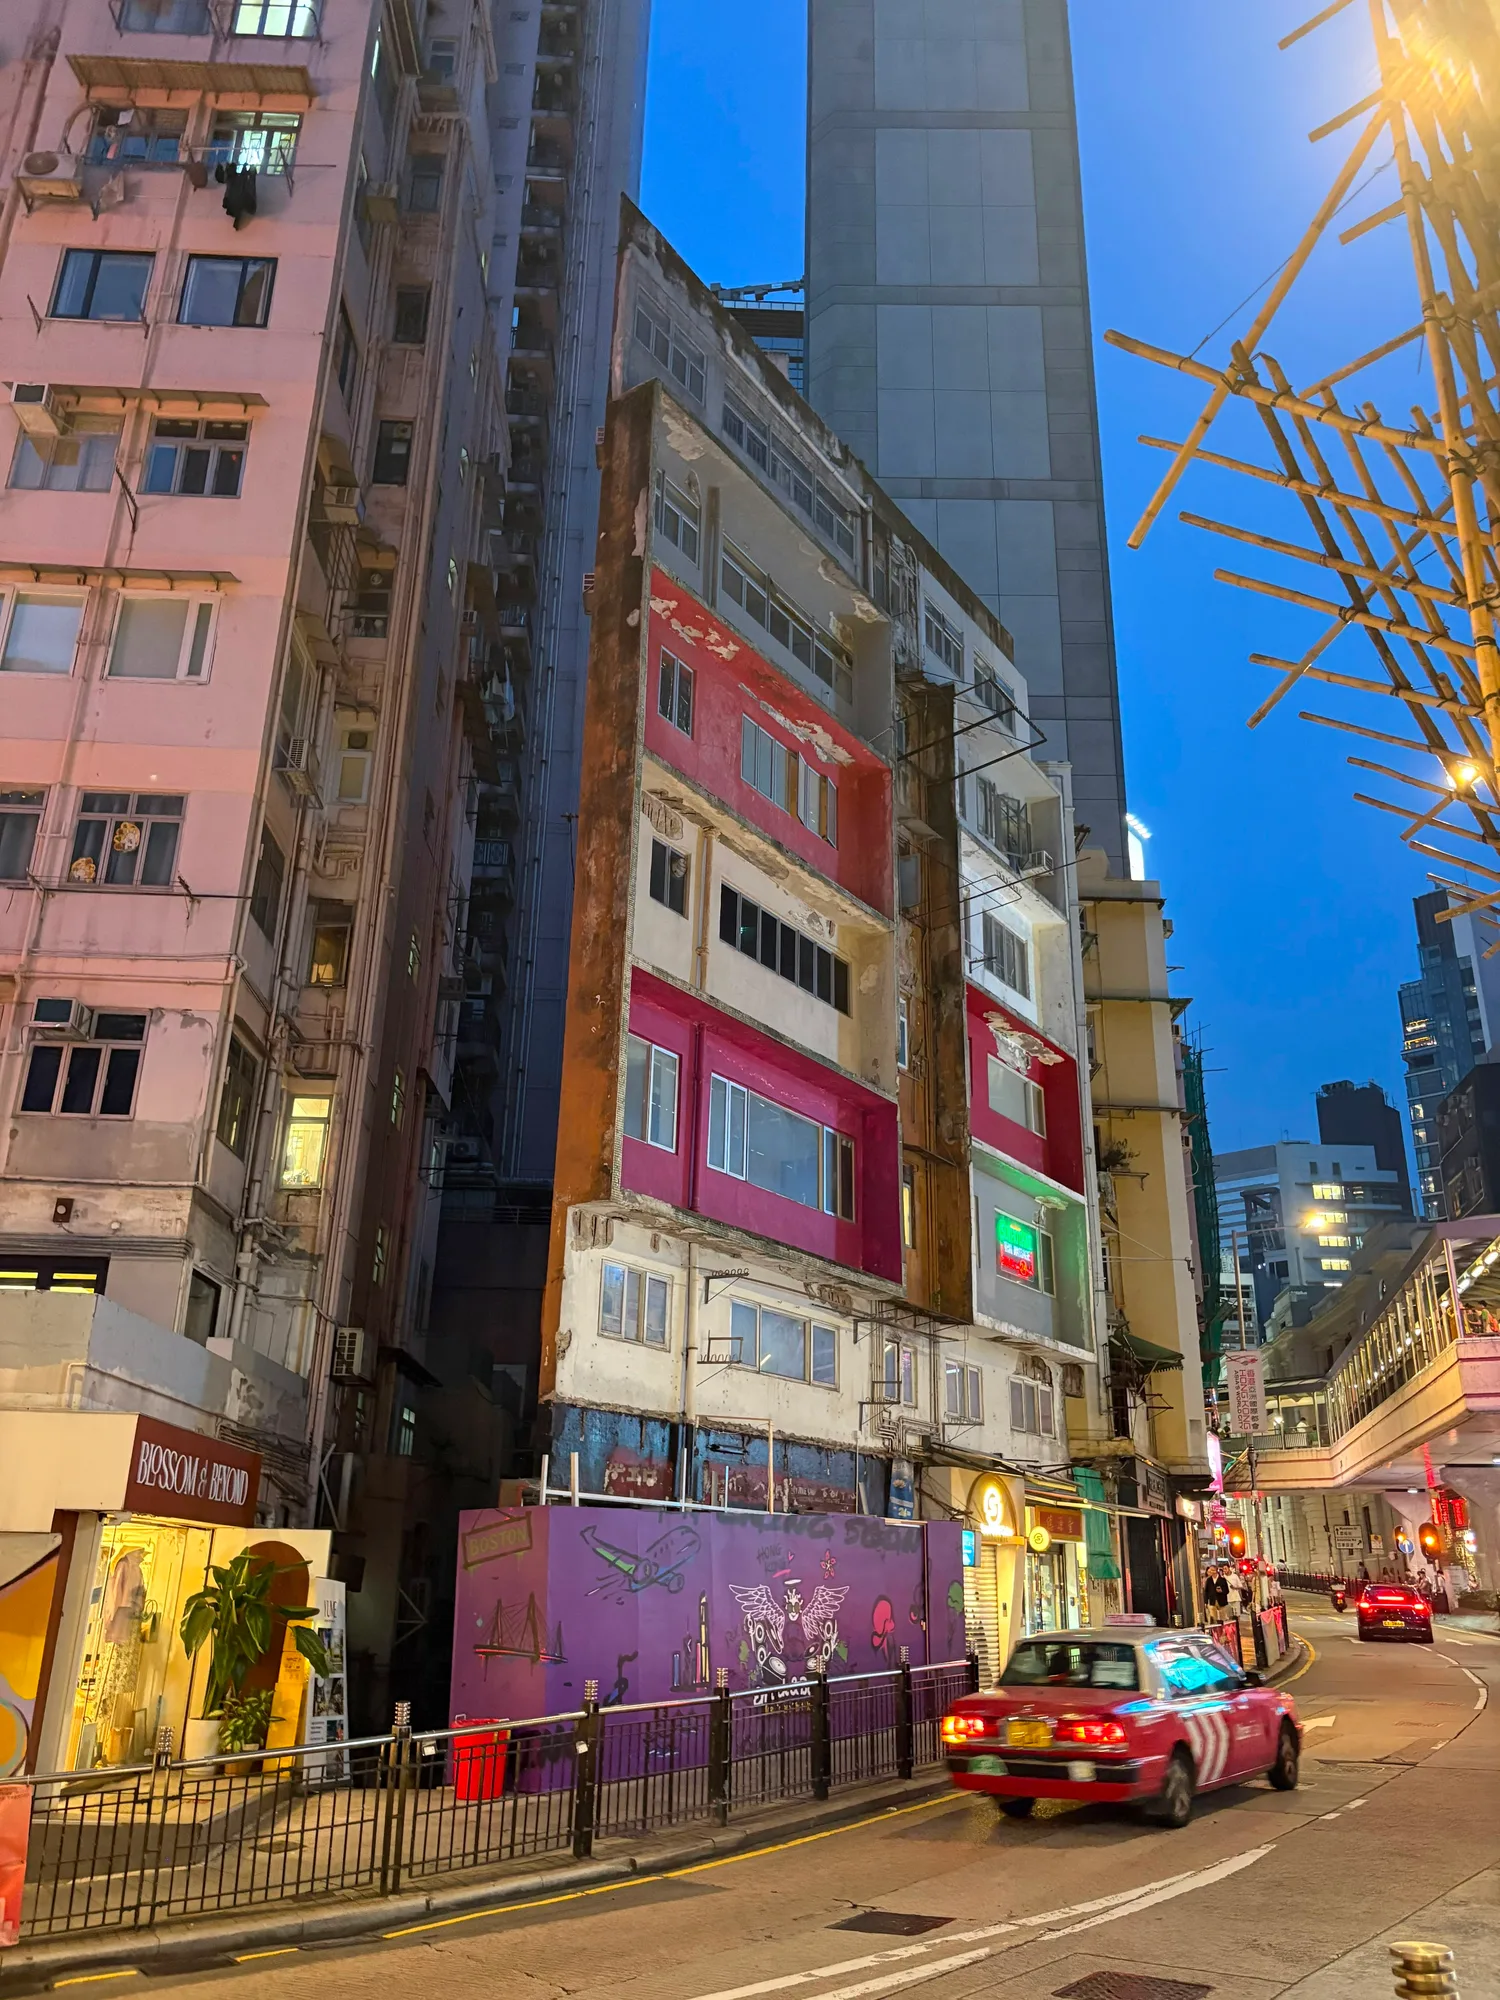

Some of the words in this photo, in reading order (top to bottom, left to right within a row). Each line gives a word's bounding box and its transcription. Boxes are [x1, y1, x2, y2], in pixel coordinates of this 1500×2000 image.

[1239, 1369, 1248, 1399] HONG
[1242, 1400, 1251, 1430] KONG
[136, 1441, 200, 1496] BLOSSOM
[208, 1462, 249, 1506] BEYOND
[469, 1527, 527, 1557] BOSTON
[757, 1543, 782, 1563] HONG
